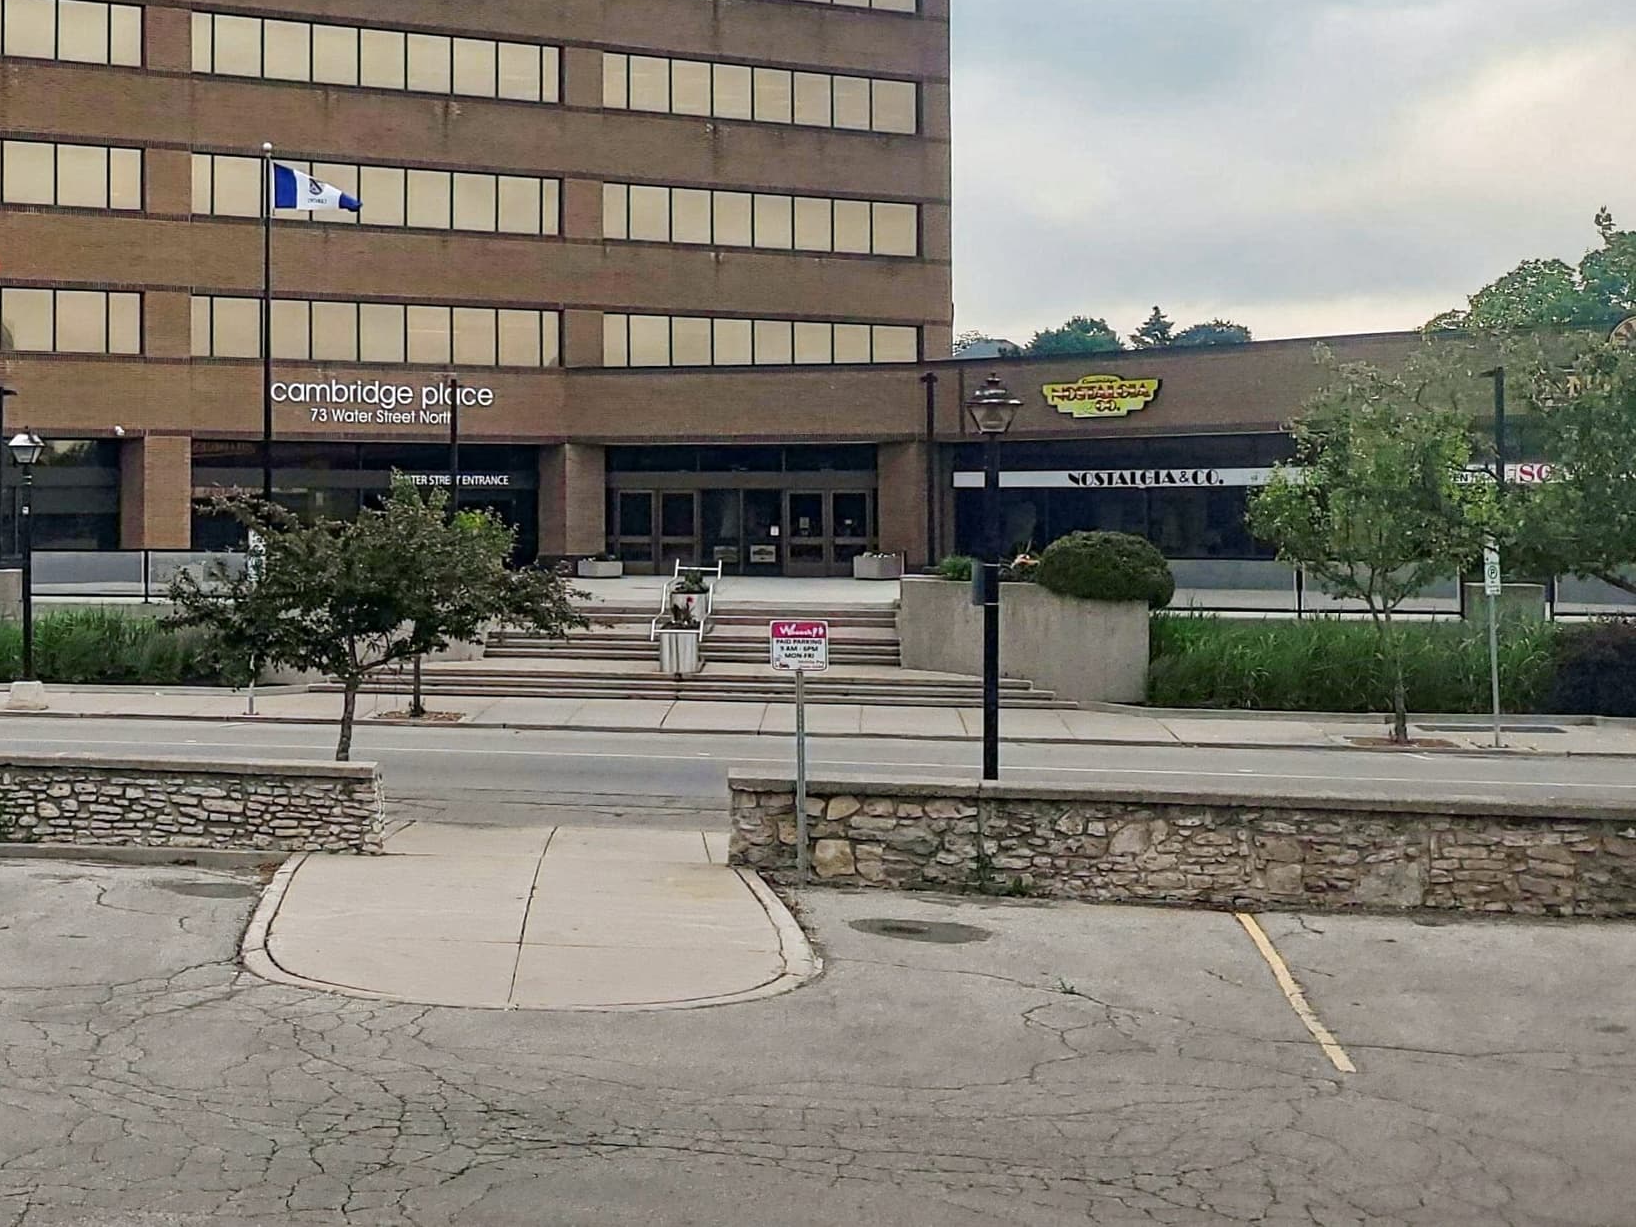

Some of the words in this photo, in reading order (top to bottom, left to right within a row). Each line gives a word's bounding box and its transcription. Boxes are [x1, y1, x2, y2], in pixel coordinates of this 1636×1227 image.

[270, 379, 413, 409] cambridge
[1051, 382, 1151, 401] NOSTALGIA
[310, 408, 328, 422] 73
[331, 409, 373, 423] Water
[376, 410, 416, 424] Street
[462, 475, 509, 485] ENTRANCE
